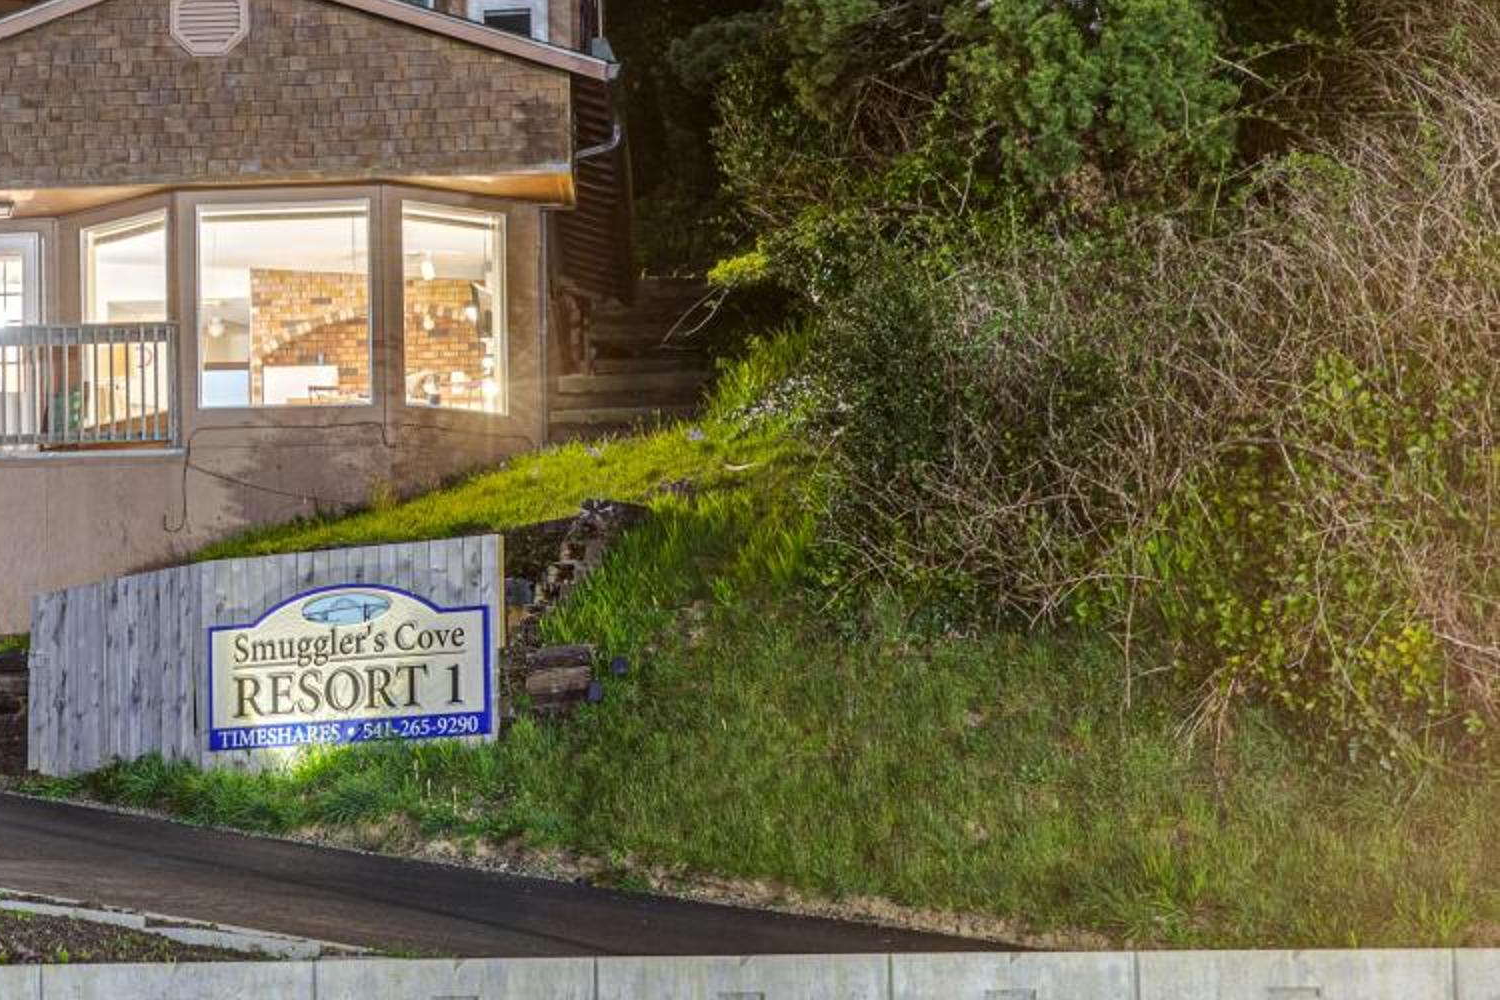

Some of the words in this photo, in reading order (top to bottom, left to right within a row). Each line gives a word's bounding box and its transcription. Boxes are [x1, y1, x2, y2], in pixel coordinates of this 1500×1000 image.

[234, 628, 387, 667] Smuggler's
[394, 621, 466, 650] Cove
[234, 664, 428, 718] RESORT
[446, 663, 464, 704] 1
[218, 723, 341, 748] TIMESHARES
[363, 714, 479, 740] 541-265-9290
